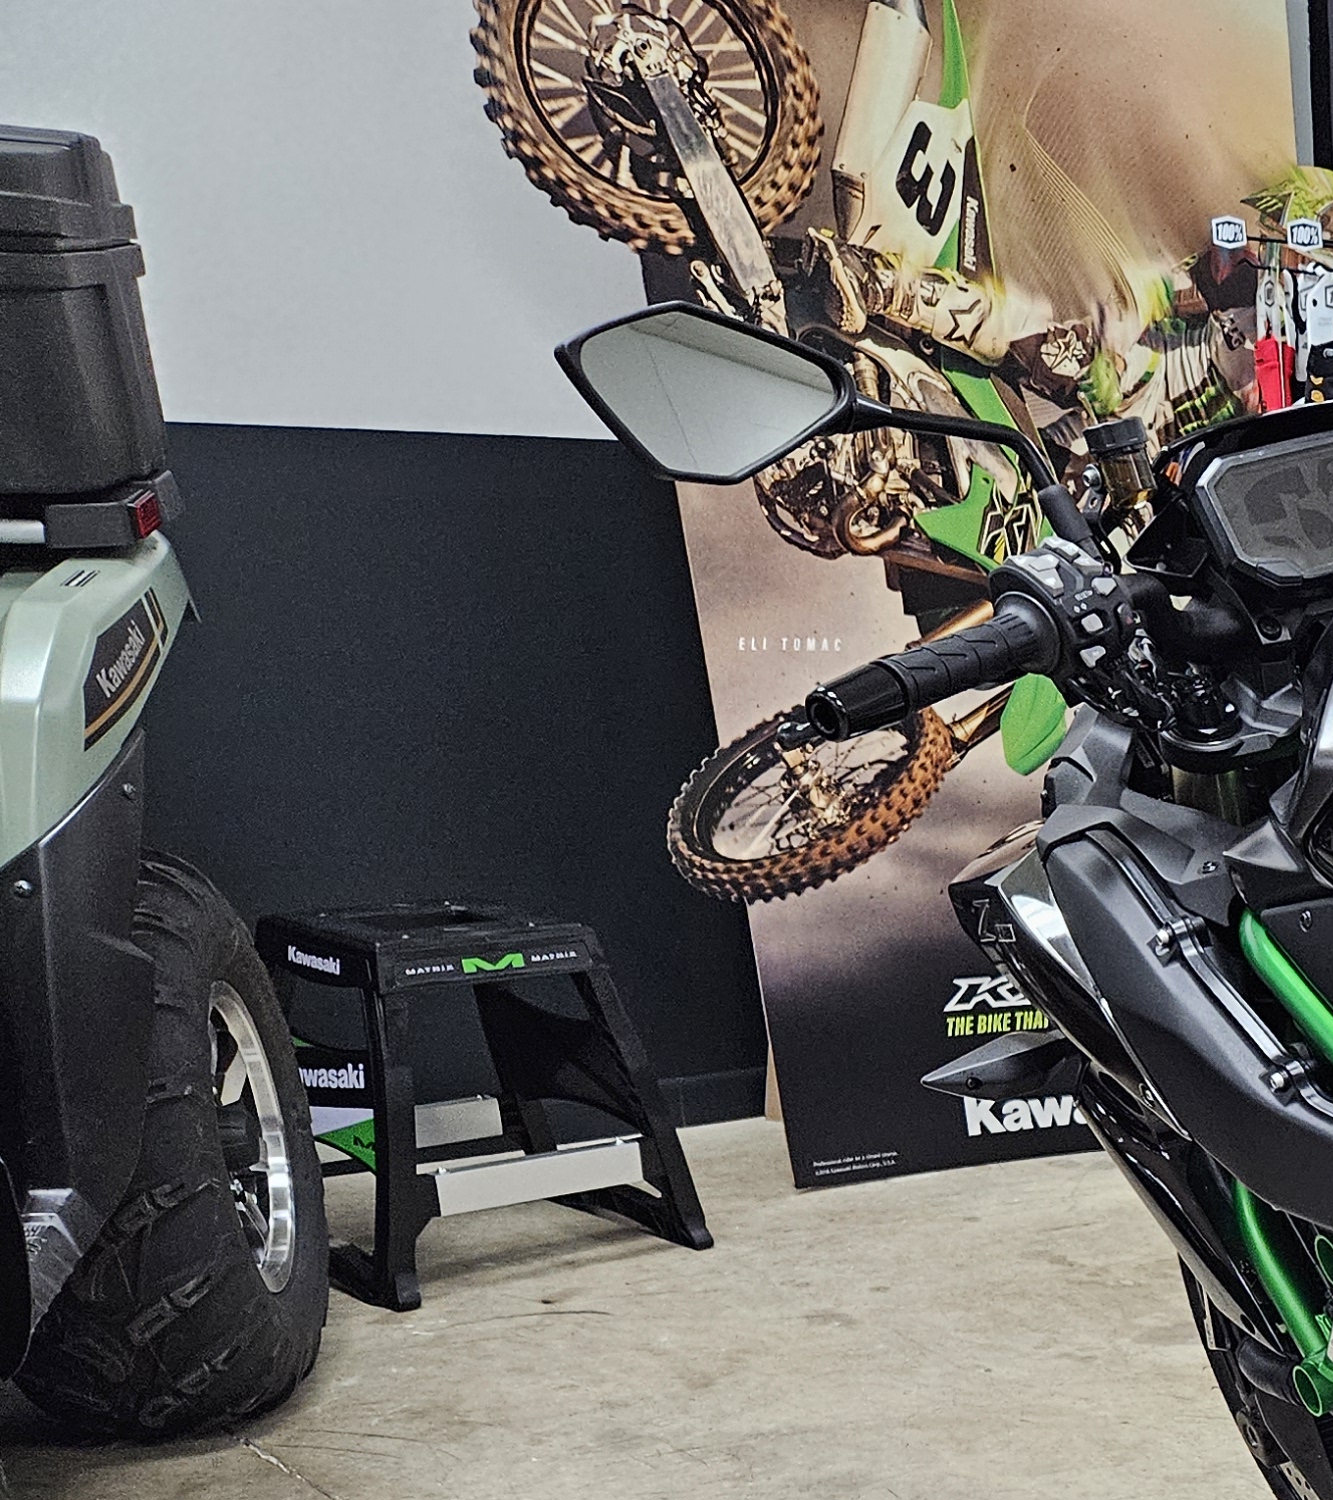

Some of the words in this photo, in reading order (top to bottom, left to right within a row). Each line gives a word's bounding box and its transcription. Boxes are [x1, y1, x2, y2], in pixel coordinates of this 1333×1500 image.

[895, 121, 956, 236] 3
[963, 196, 979, 272] Kawasaki
[1217, 222, 1243, 241] 100%
[1292, 225, 1319, 245] 100%
[738, 636, 768, 651] ELI
[781, 637, 843, 652] TOMAC
[95, 618, 147, 699] Kawasaki
[287, 944, 341, 976] Kawasaki
[946, 1016, 974, 1037] THE
[977, 1012, 1011, 1035] BIKE
[298, 1062, 365, 1090] wasaki
